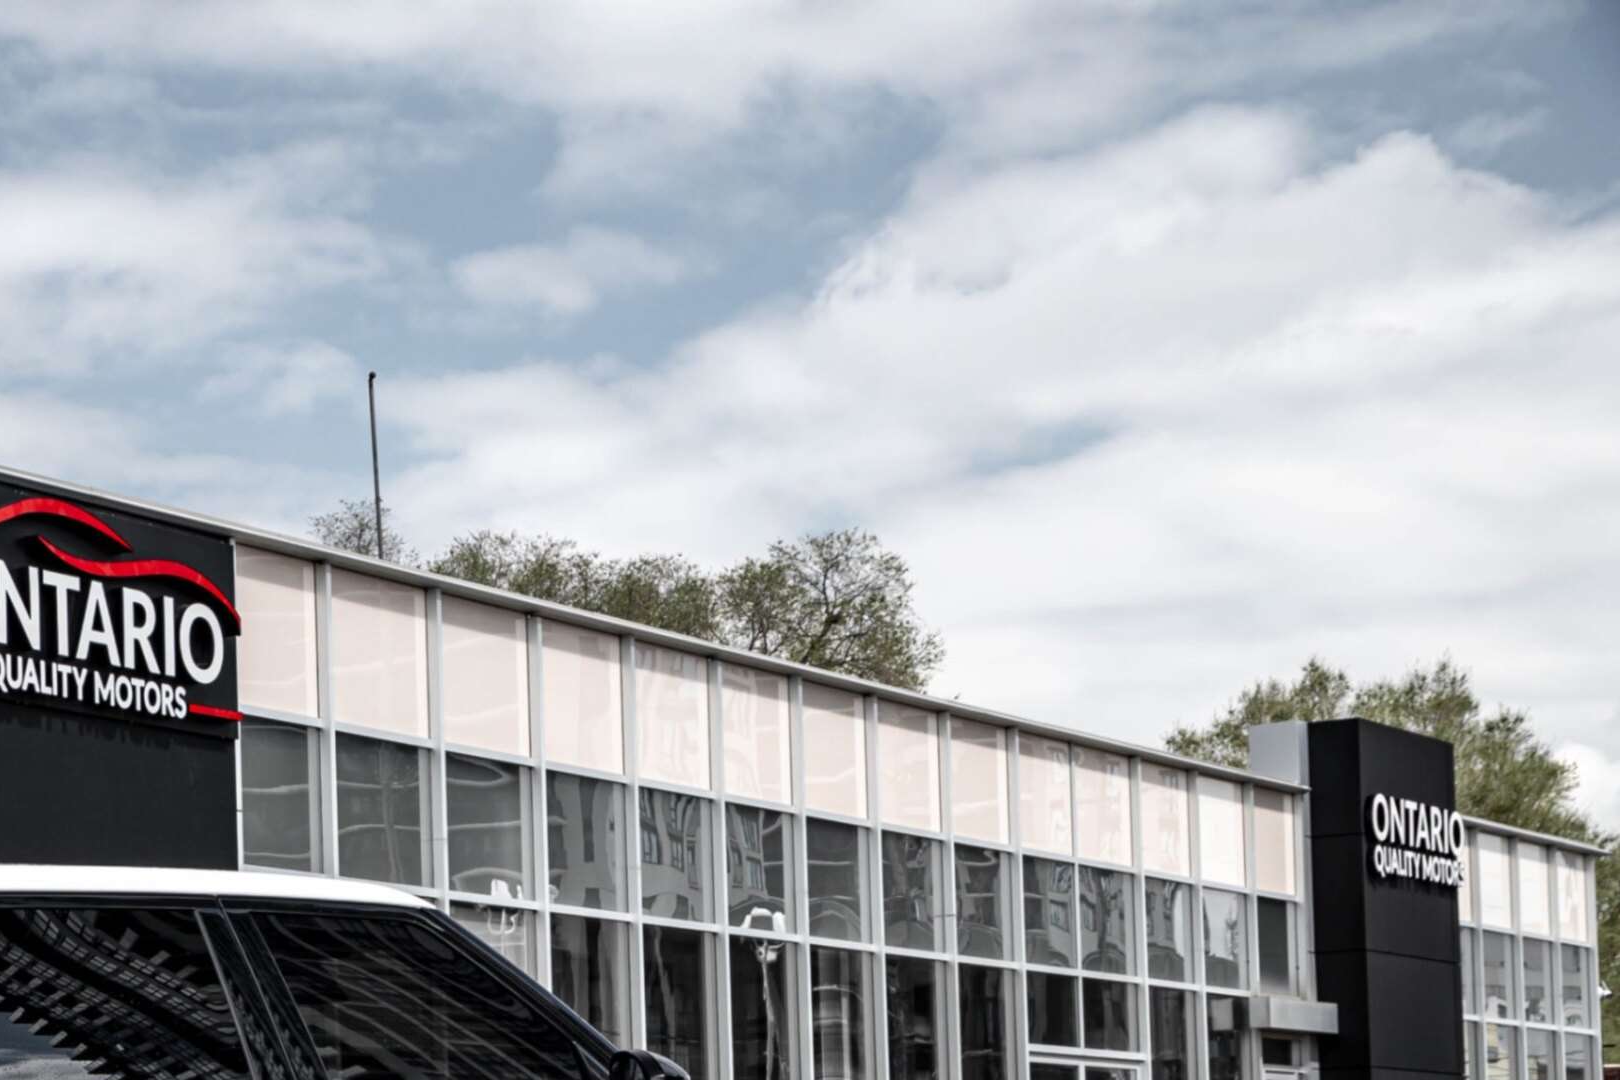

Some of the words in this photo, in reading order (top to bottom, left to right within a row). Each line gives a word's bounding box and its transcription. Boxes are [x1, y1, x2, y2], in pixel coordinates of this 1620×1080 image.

[93, 670, 187, 719] MOTORS
[1371, 793, 1465, 856] ONTARIO
[1374, 844, 1421, 878] QUALITY
